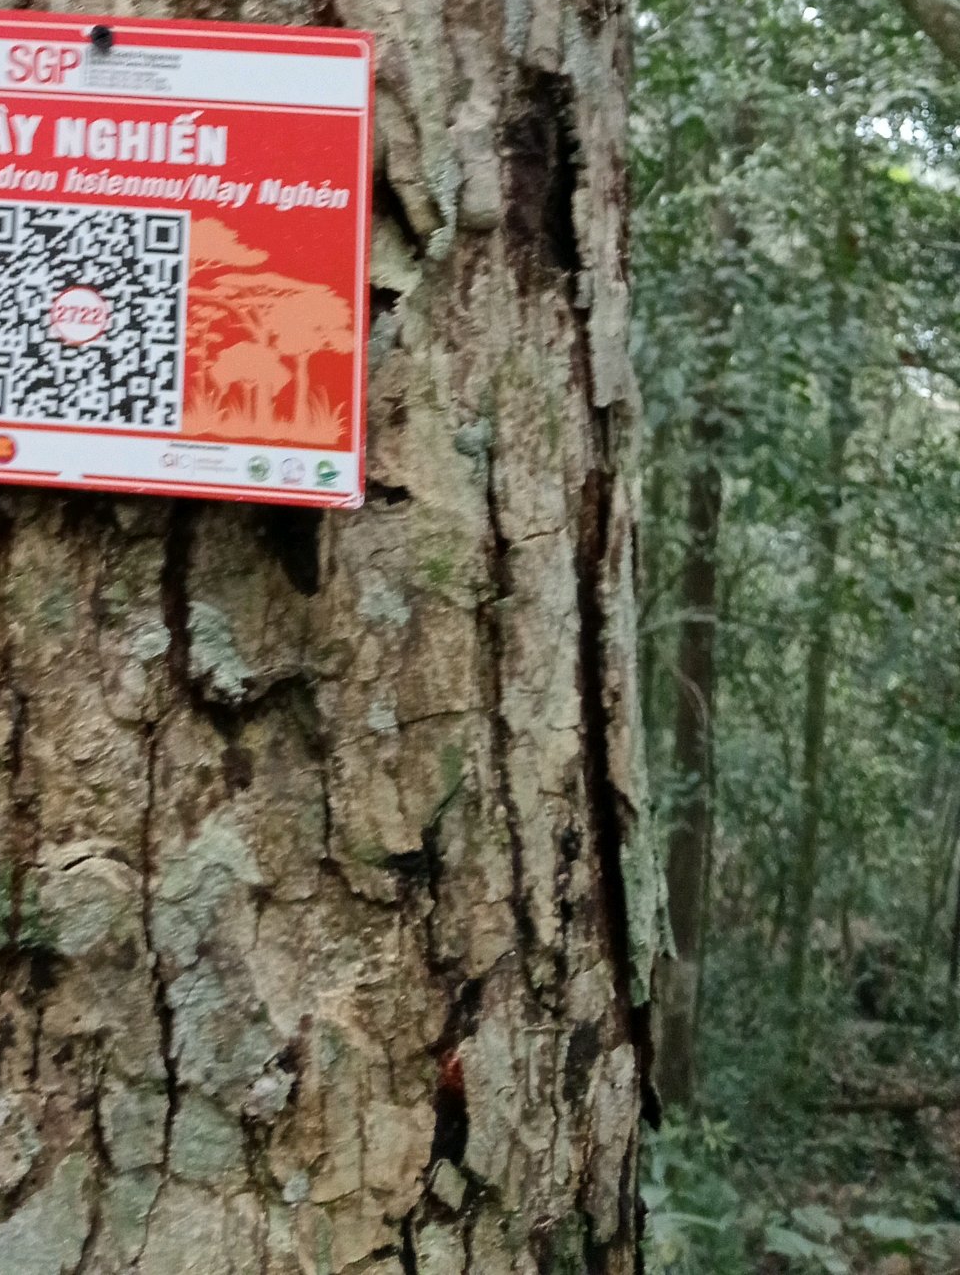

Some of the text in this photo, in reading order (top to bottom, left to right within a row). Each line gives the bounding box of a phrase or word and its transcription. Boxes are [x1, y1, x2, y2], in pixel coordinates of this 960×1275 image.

[8, 44, 81, 84] SGP
[54, 110, 228, 165] NGHIẾN
[51, 306, 102, 325] 2722
